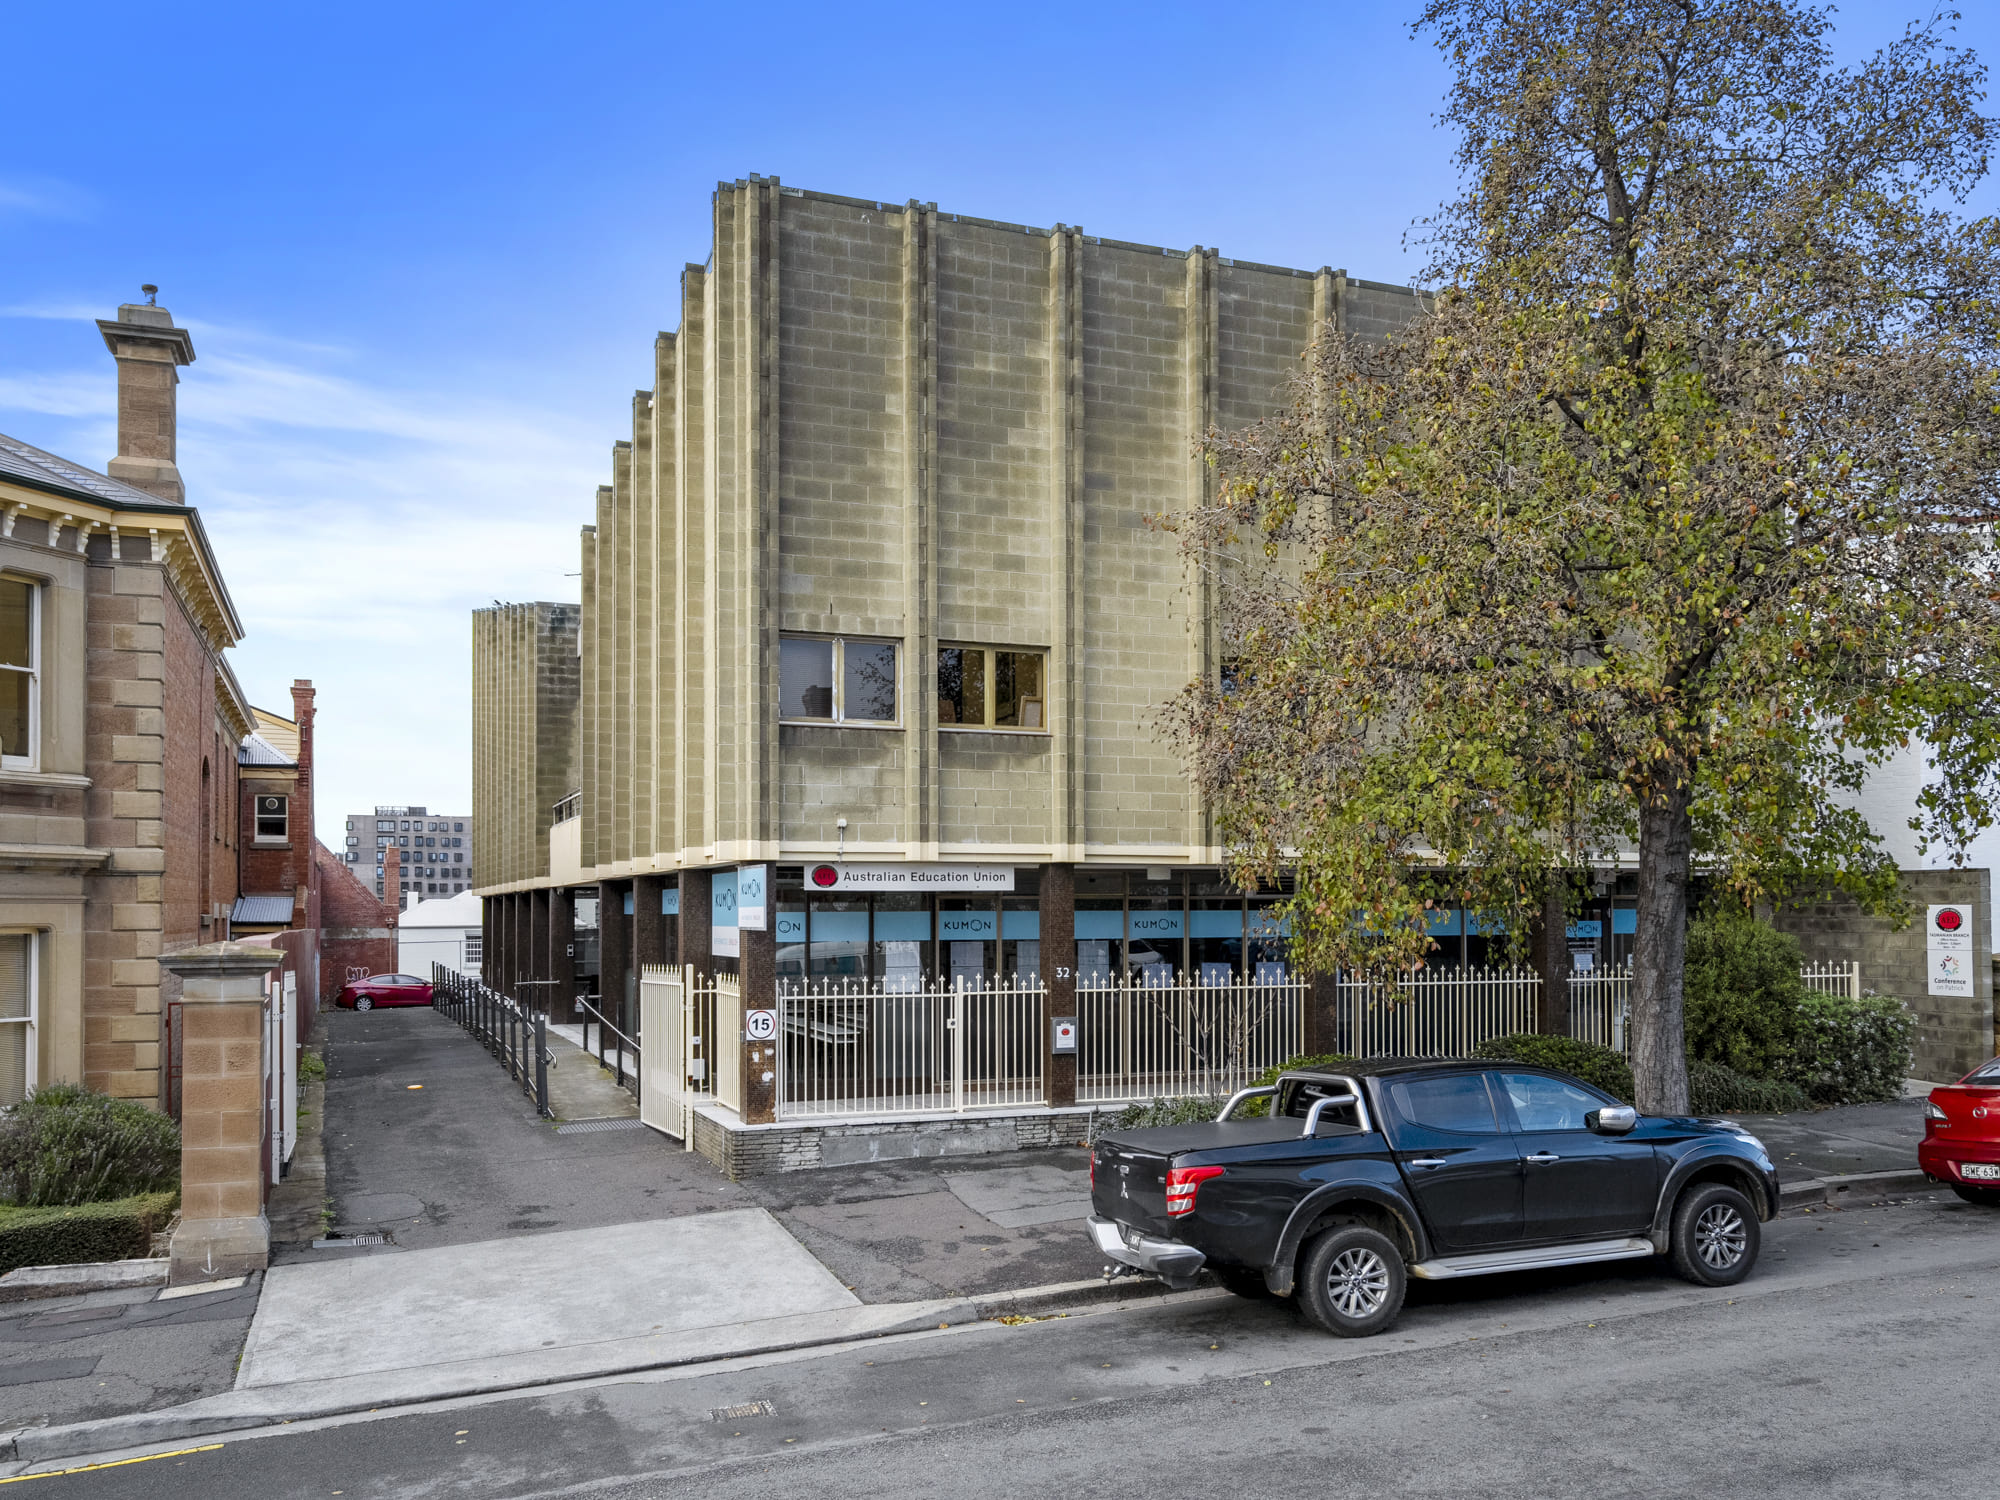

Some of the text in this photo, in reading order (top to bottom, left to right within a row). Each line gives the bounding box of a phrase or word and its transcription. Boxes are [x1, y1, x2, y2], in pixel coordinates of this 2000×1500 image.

[844, 871, 1006, 882] Australian Education Union
[741, 878, 761, 898] KUMON
[715, 888, 737, 911] KUMON
[944, 919, 991, 931] KUMON
[1134, 918, 1178, 930] KUMON
[1941, 916, 1957, 924] AEU
[1056, 967, 1070, 978] 32
[752, 1018, 770, 1031] 15
